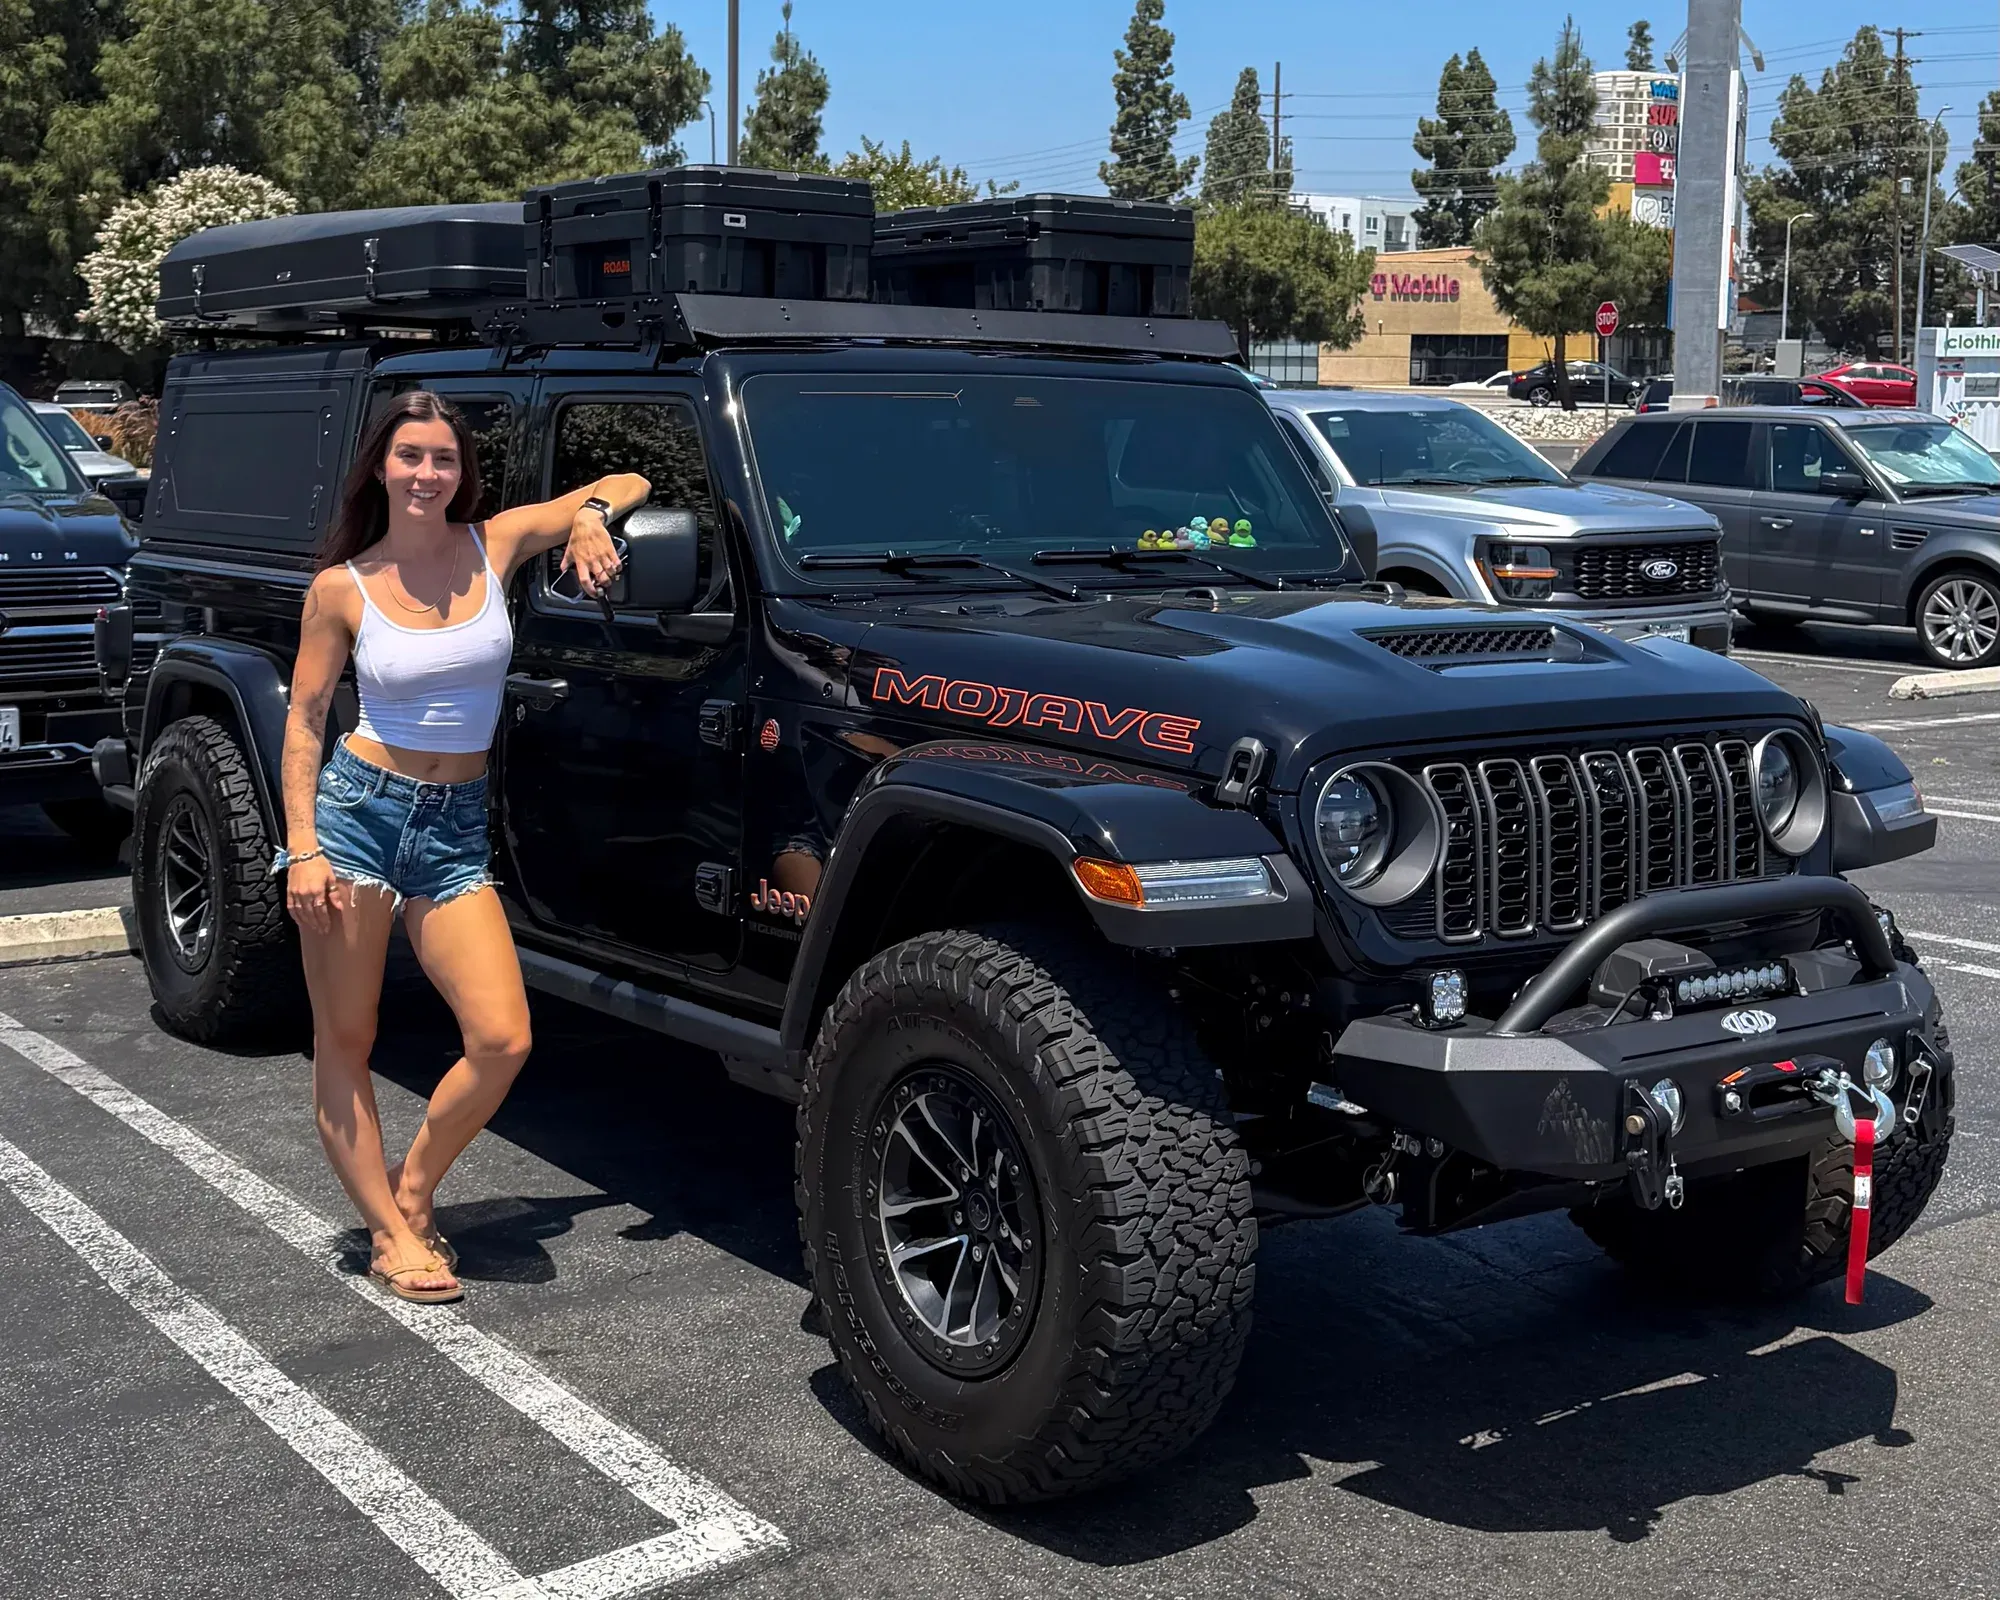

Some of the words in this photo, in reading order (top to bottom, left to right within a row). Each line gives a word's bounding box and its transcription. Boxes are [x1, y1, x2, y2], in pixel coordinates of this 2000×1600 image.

[603, 260, 630, 274] ROAM
[1391, 273, 1460, 297] Mobile
[1598, 311, 1617, 326] STOP
[1651, 564, 1673, 577] Ford
[872, 667, 1201, 753] MOJAVE
[751, 878, 811, 926] Jeep
